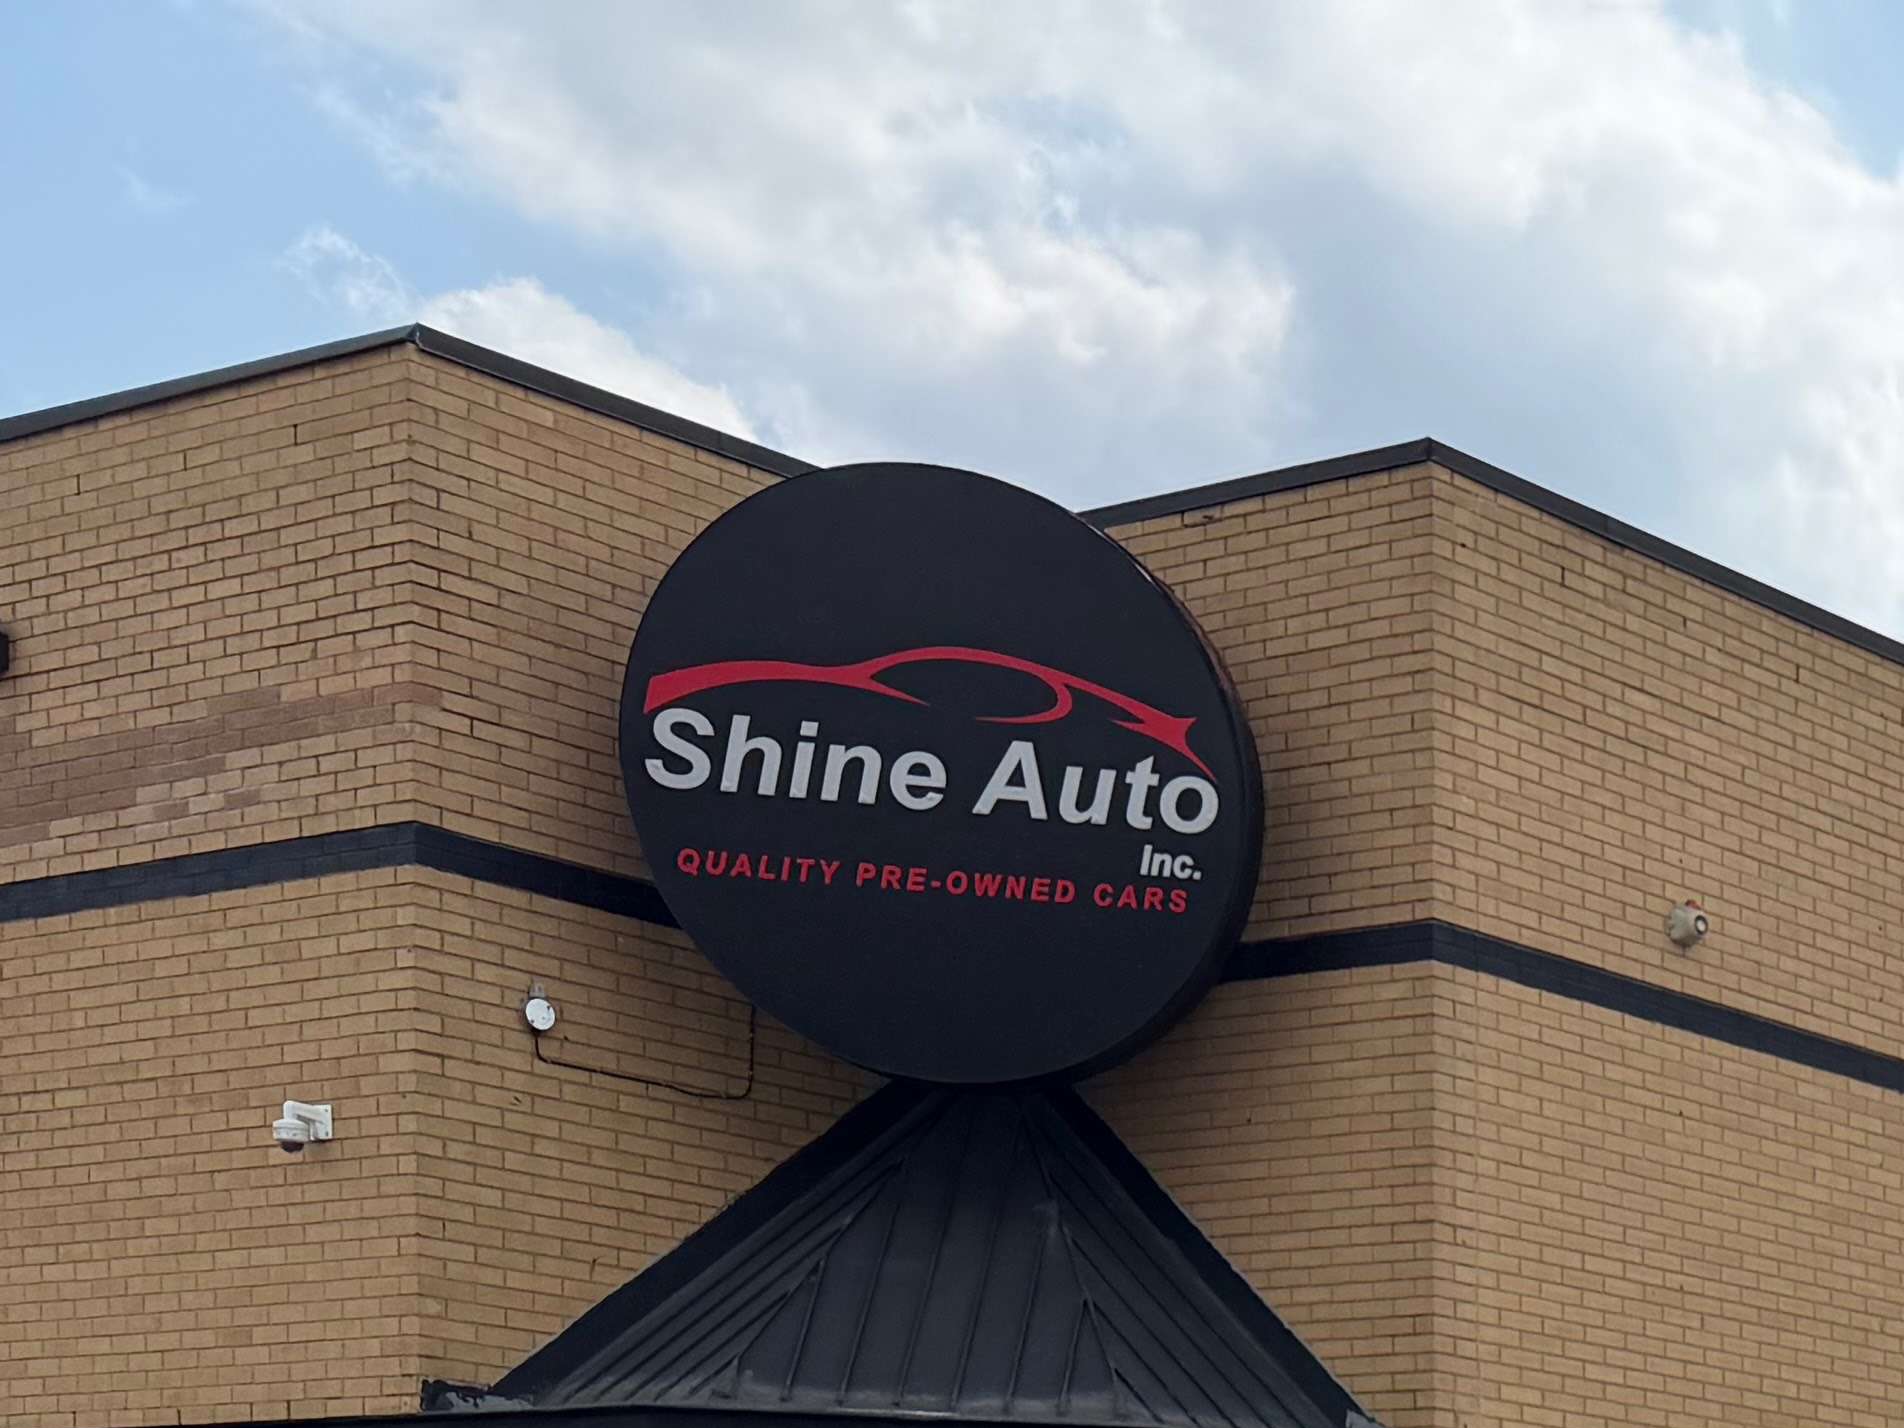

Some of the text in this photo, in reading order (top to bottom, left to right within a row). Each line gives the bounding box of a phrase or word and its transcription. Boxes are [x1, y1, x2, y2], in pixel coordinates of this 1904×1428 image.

[643, 707, 1220, 835] Shine Auto
[676, 847, 1189, 914] QUALITY PRE-OWNED CARS
[1139, 844, 1204, 881] Inc.
